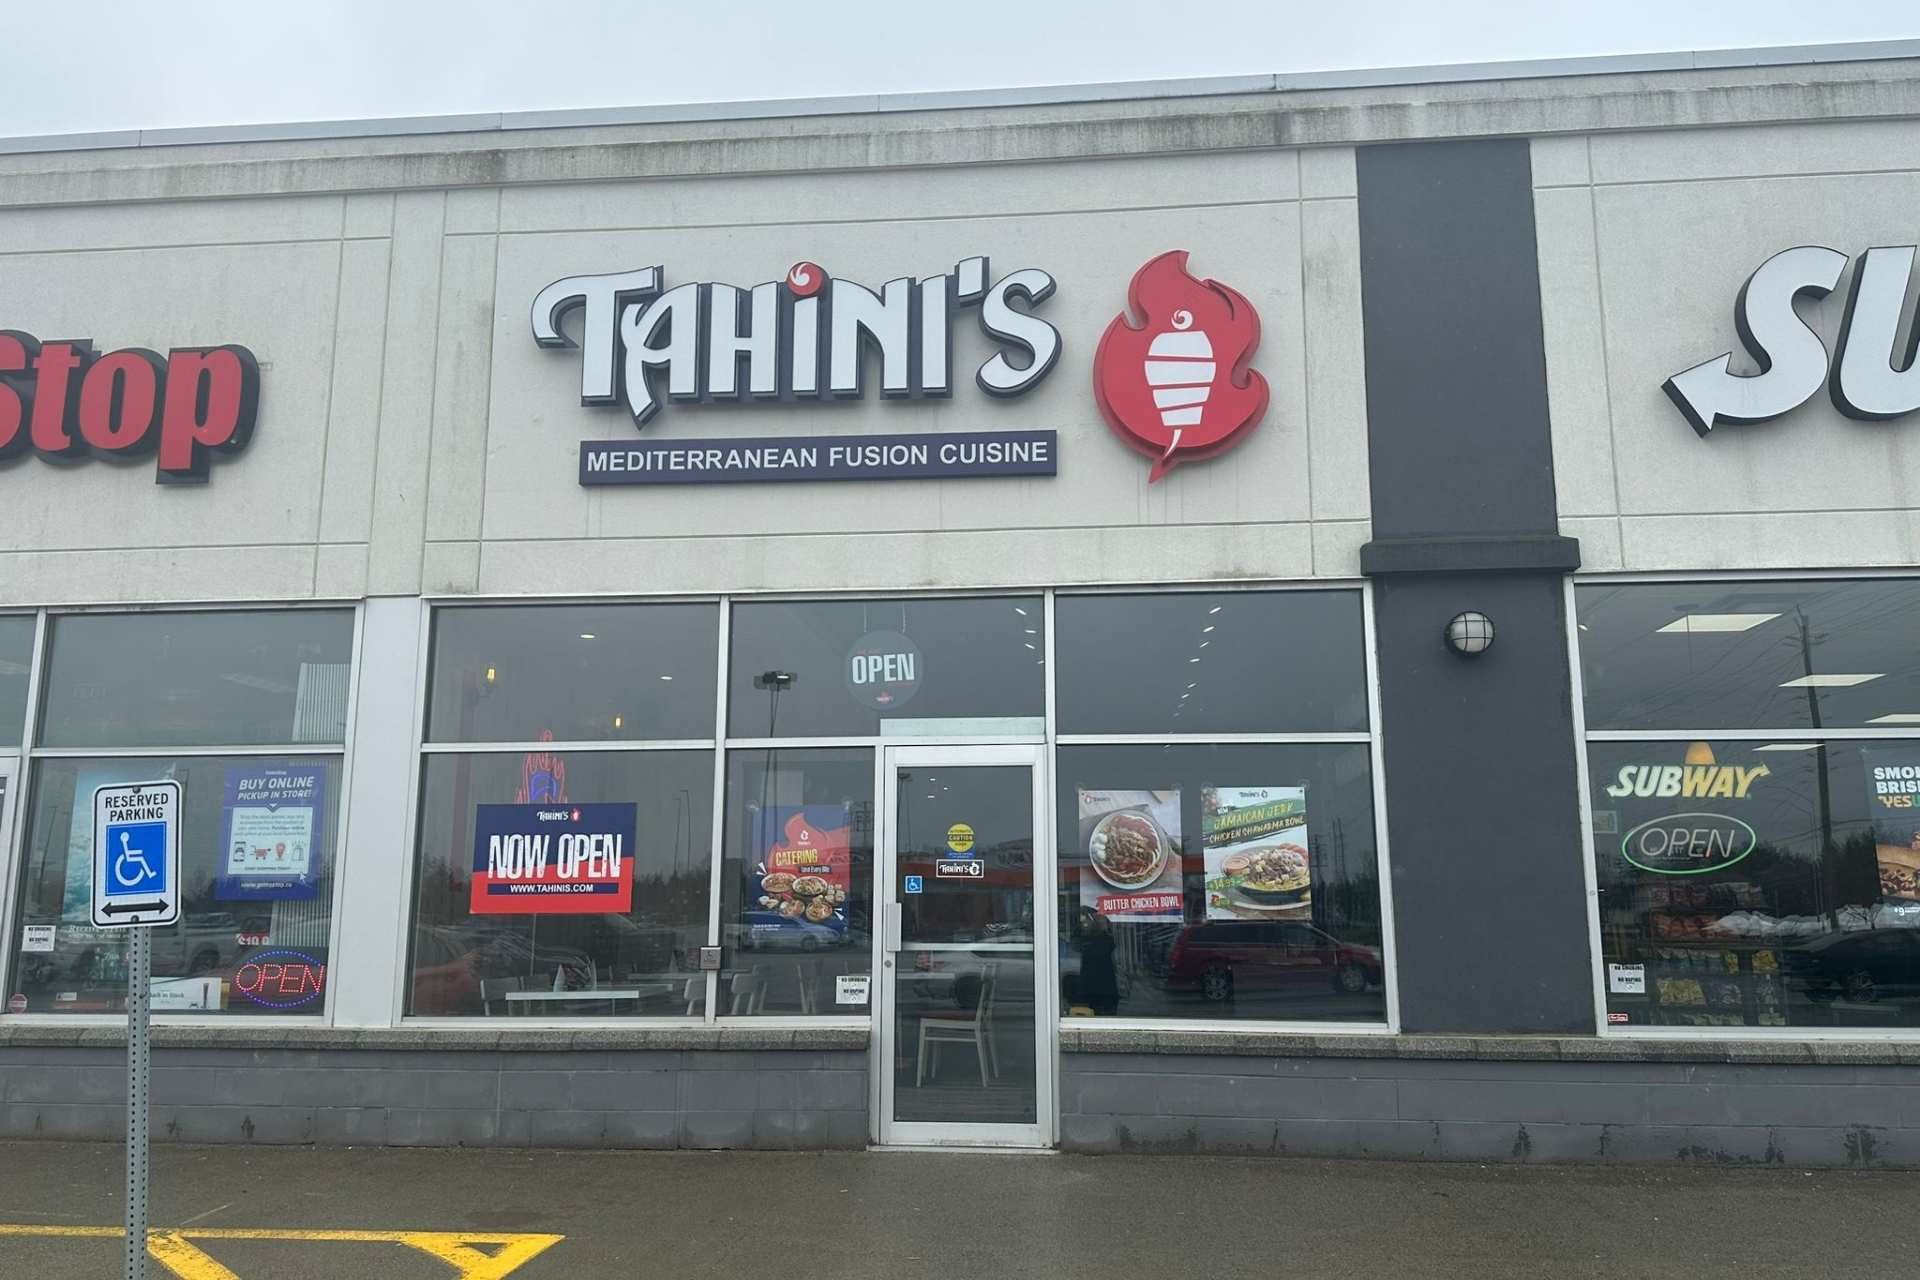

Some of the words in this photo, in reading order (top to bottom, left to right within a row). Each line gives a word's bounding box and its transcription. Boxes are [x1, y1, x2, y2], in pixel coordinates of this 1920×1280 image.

[586, 447, 818, 472] MEDITERRANEAN
[828, 444, 928, 467] FUSION
[938, 441, 1049, 465] CUISINE
[851, 653, 915, 684] OPEN
[239, 778, 266, 791] BUY
[268, 776, 315, 789] ONLINE
[1606, 763, 1771, 798] SUBWAY
[1875, 780, 1920, 794] BRIS
[105, 792, 169, 809] RESERVED
[110, 806, 164, 823] PARKING
[1214, 807, 1265, 830] JAMAICAN
[1209, 828, 1242, 844] CHICKEN
[1640, 828, 1735, 858] OPEN
[487, 834, 550, 880] NOW
[557, 833, 622, 879] OPEN
[775, 848, 818, 866] CATERING
[510, 883, 595, 893] WWW.TAHINIS.COM
[1103, 899, 1130, 911] BUTTER
[1131, 896, 1159, 908] CHICKEN
[1160, 895, 1180, 907] BOWL
[235, 962, 326, 994] OPEN
